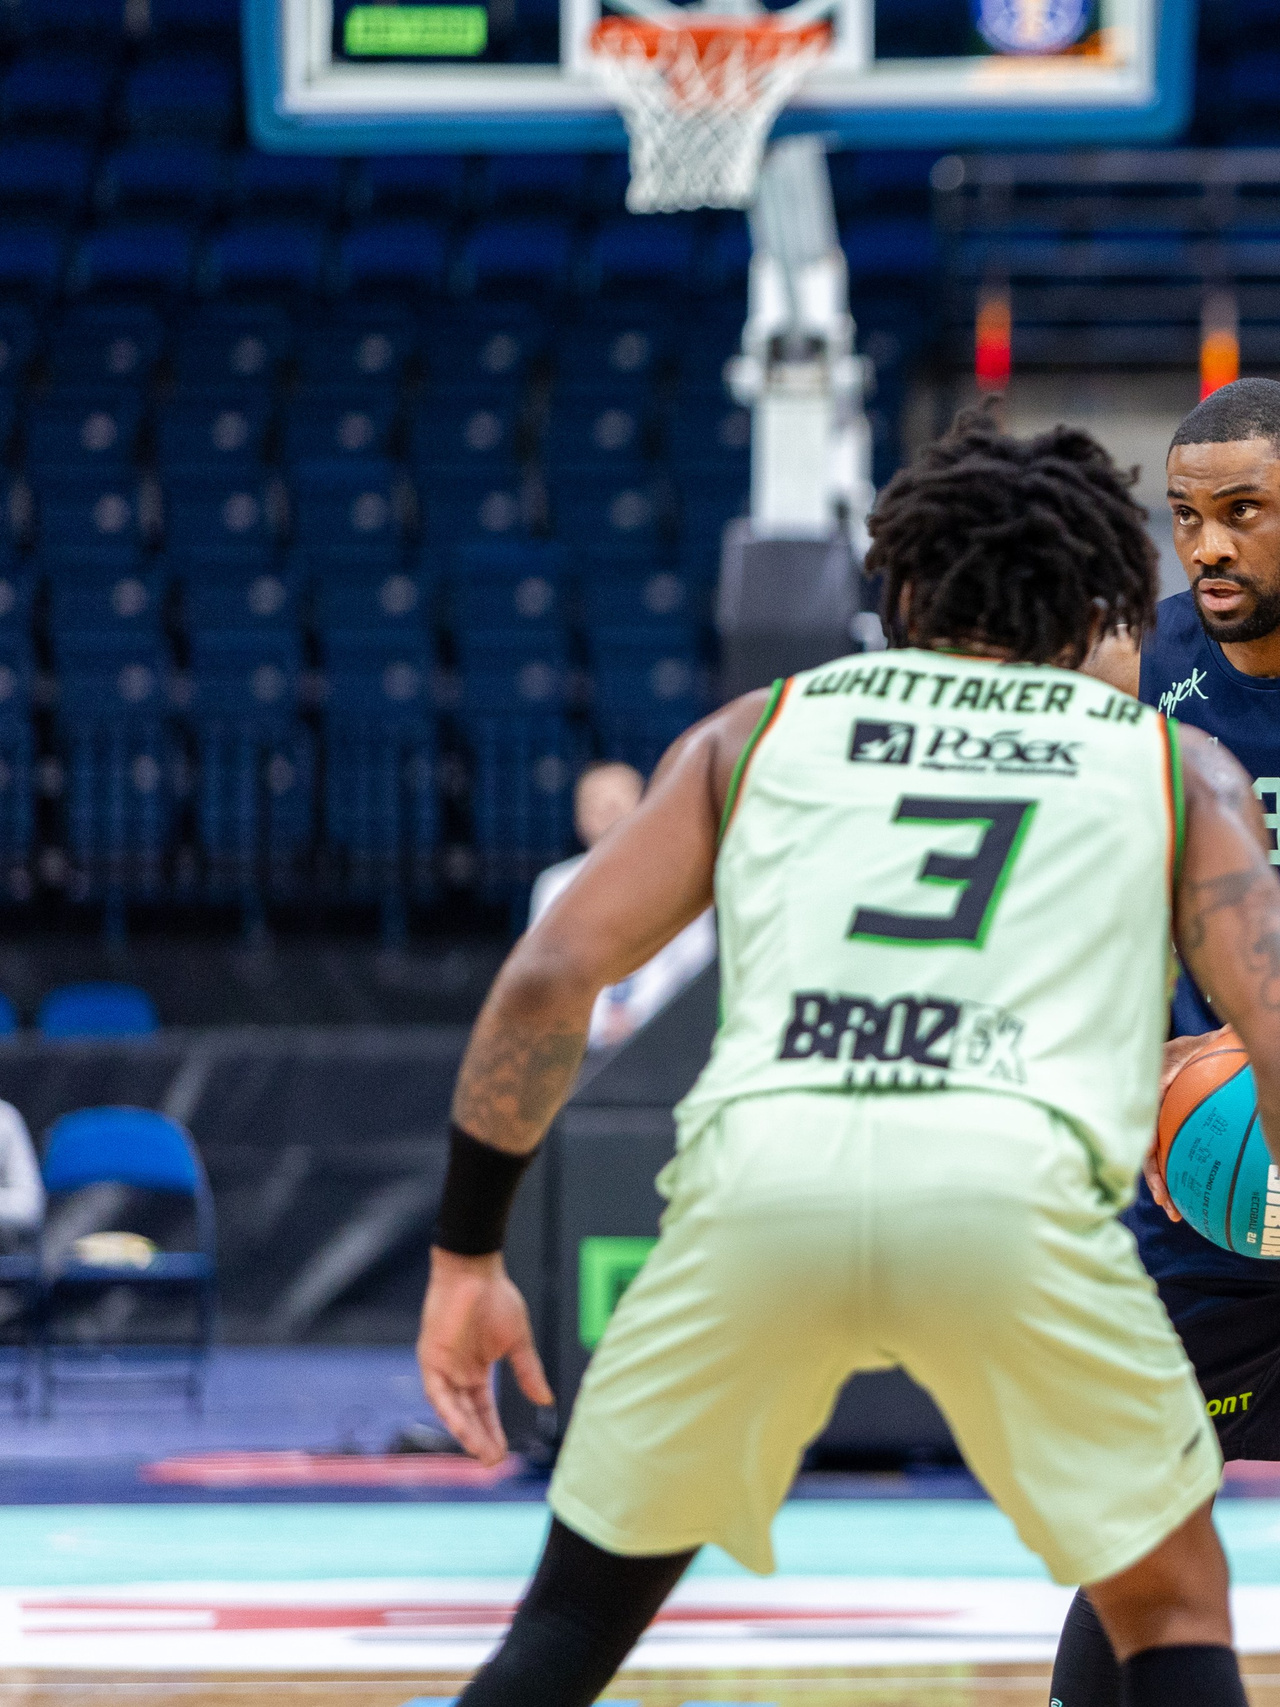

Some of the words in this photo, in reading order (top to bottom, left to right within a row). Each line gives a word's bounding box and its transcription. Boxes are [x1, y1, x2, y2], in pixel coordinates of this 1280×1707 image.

[802, 665, 1076, 714] WHITTAKER
[1085, 695, 1141, 726] JR
[846, 793, 1039, 951] 3
[1205, 1159, 1221, 1191] SECOND
